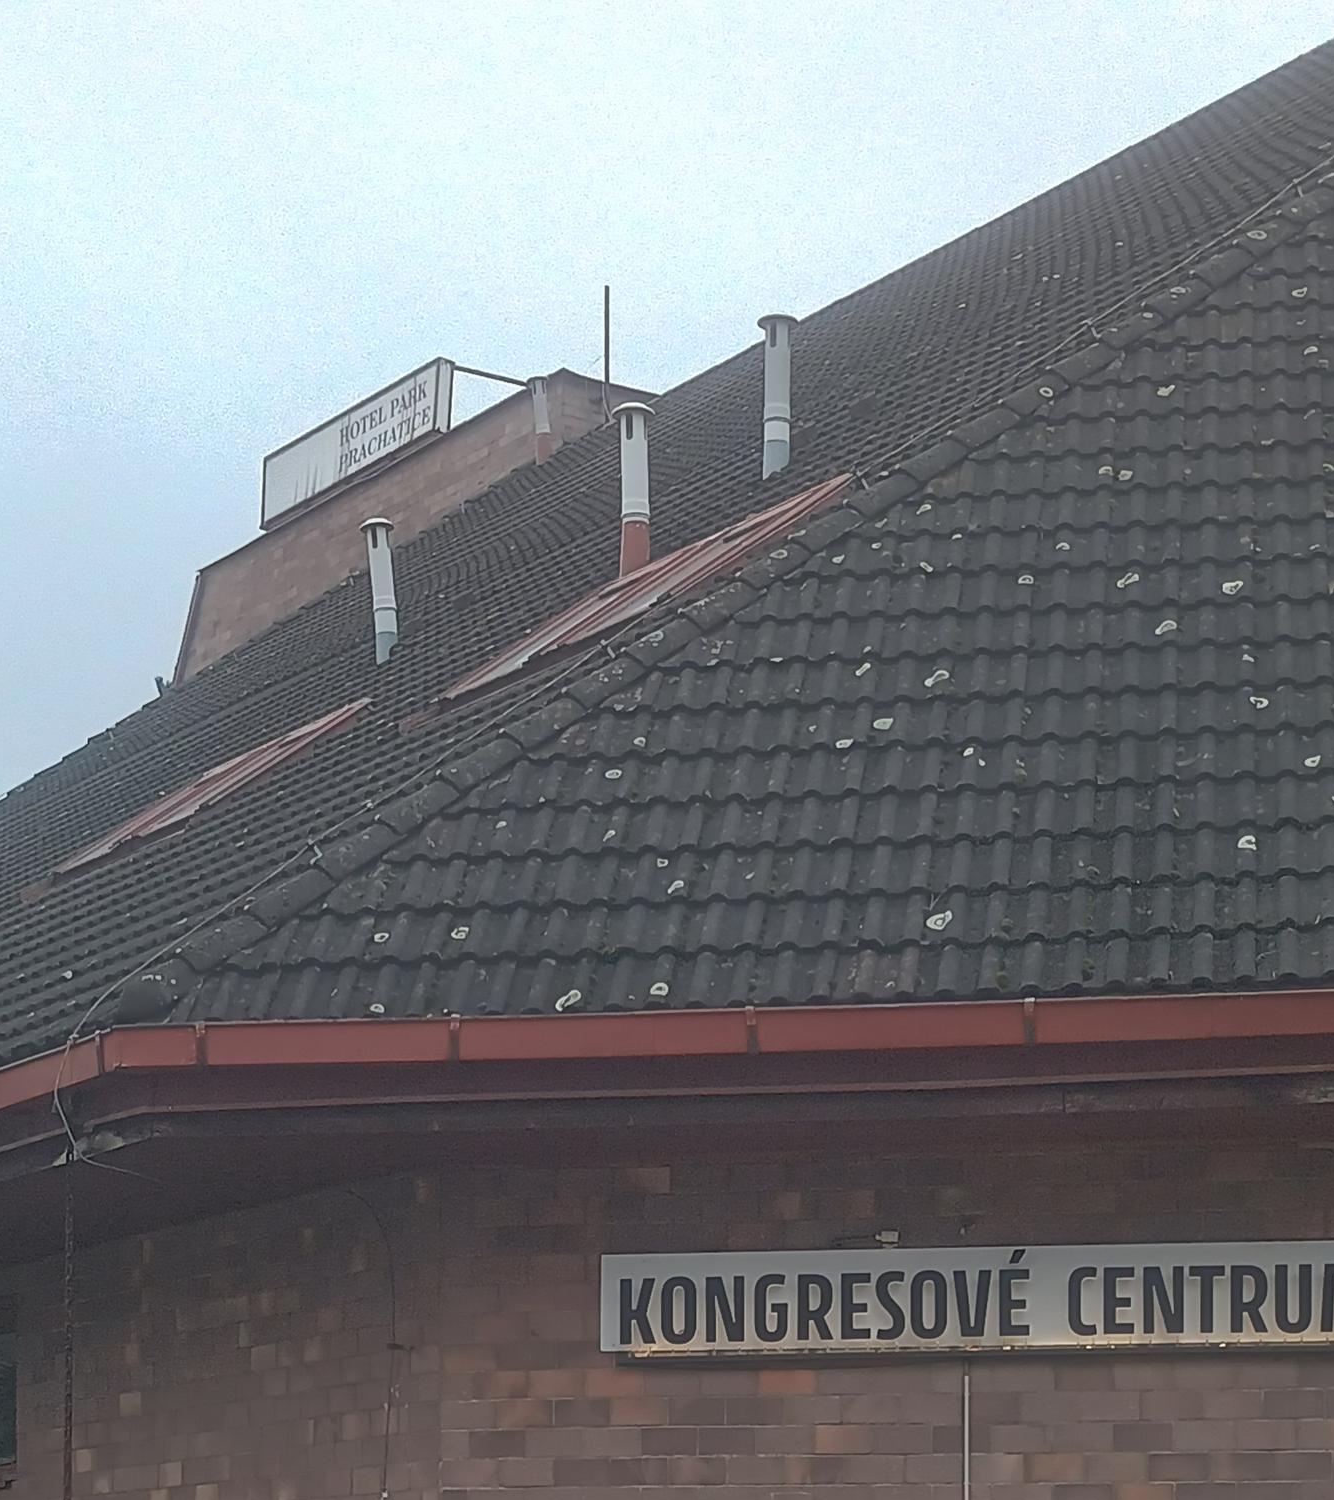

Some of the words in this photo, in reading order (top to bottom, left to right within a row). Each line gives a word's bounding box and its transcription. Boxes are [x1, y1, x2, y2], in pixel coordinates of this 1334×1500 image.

[338, 405, 431, 474] PRACHATICE
[339, 407, 387, 447] HOTEL
[390, 380, 428, 418] PARK
[619, 1249, 1032, 1345] KONGRESOVÉ
